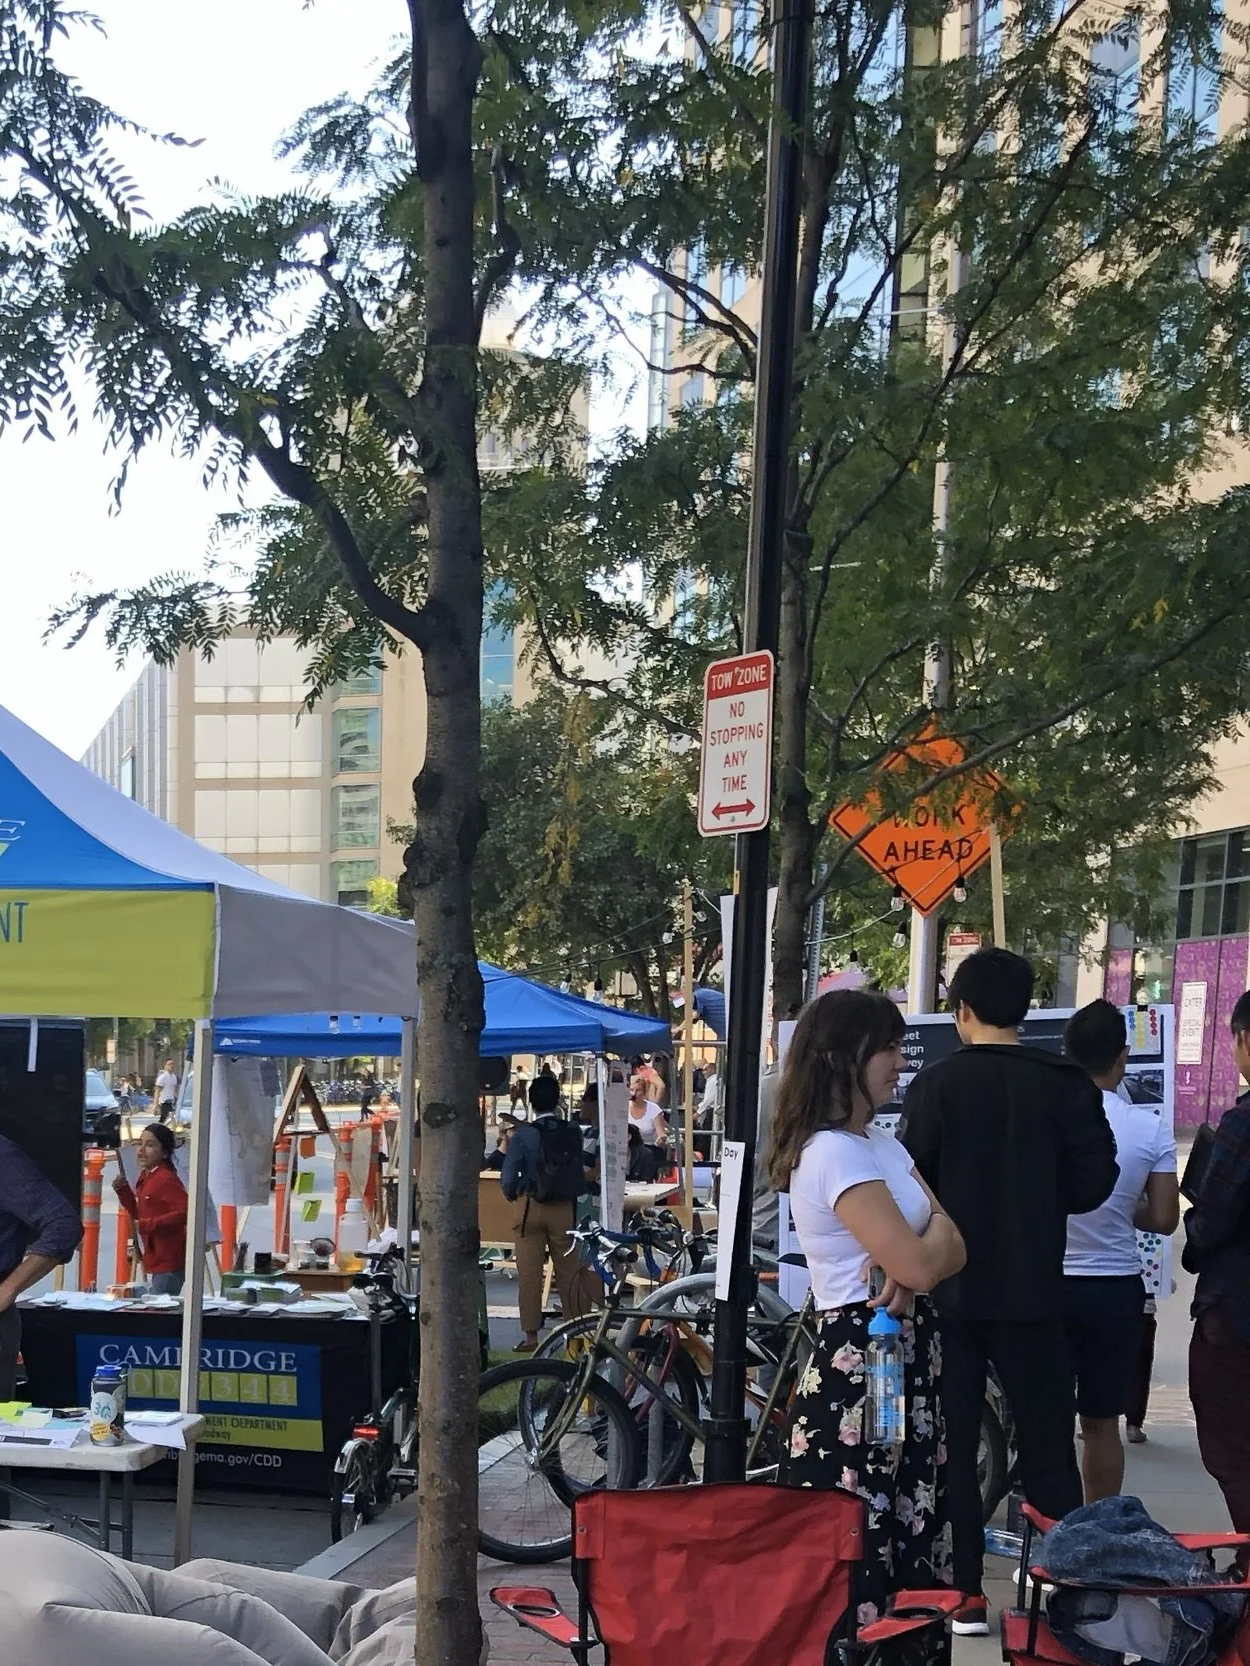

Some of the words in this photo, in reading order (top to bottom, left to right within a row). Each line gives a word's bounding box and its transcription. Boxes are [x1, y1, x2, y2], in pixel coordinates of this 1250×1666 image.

[711, 671, 733, 692] TOW
[736, 664, 767, 686] ZONE
[729, 701, 745, 718] NO
[710, 722, 764, 746] STOPPING
[723, 750, 748, 768] ANY
[722, 774, 748, 793] TIME
[883, 838, 973, 863] AHEAD
[903, 1030, 920, 1041] eet
[901, 1044, 924, 1055] sign
[907, 1058, 924, 1070] vey
[724, 1147, 739, 1160] Day
[100, 1344, 298, 1372] CAMRIDGE
[231, 1417, 288, 1431] DEPARTMENT
[201, 1428, 231, 1441] oadway
